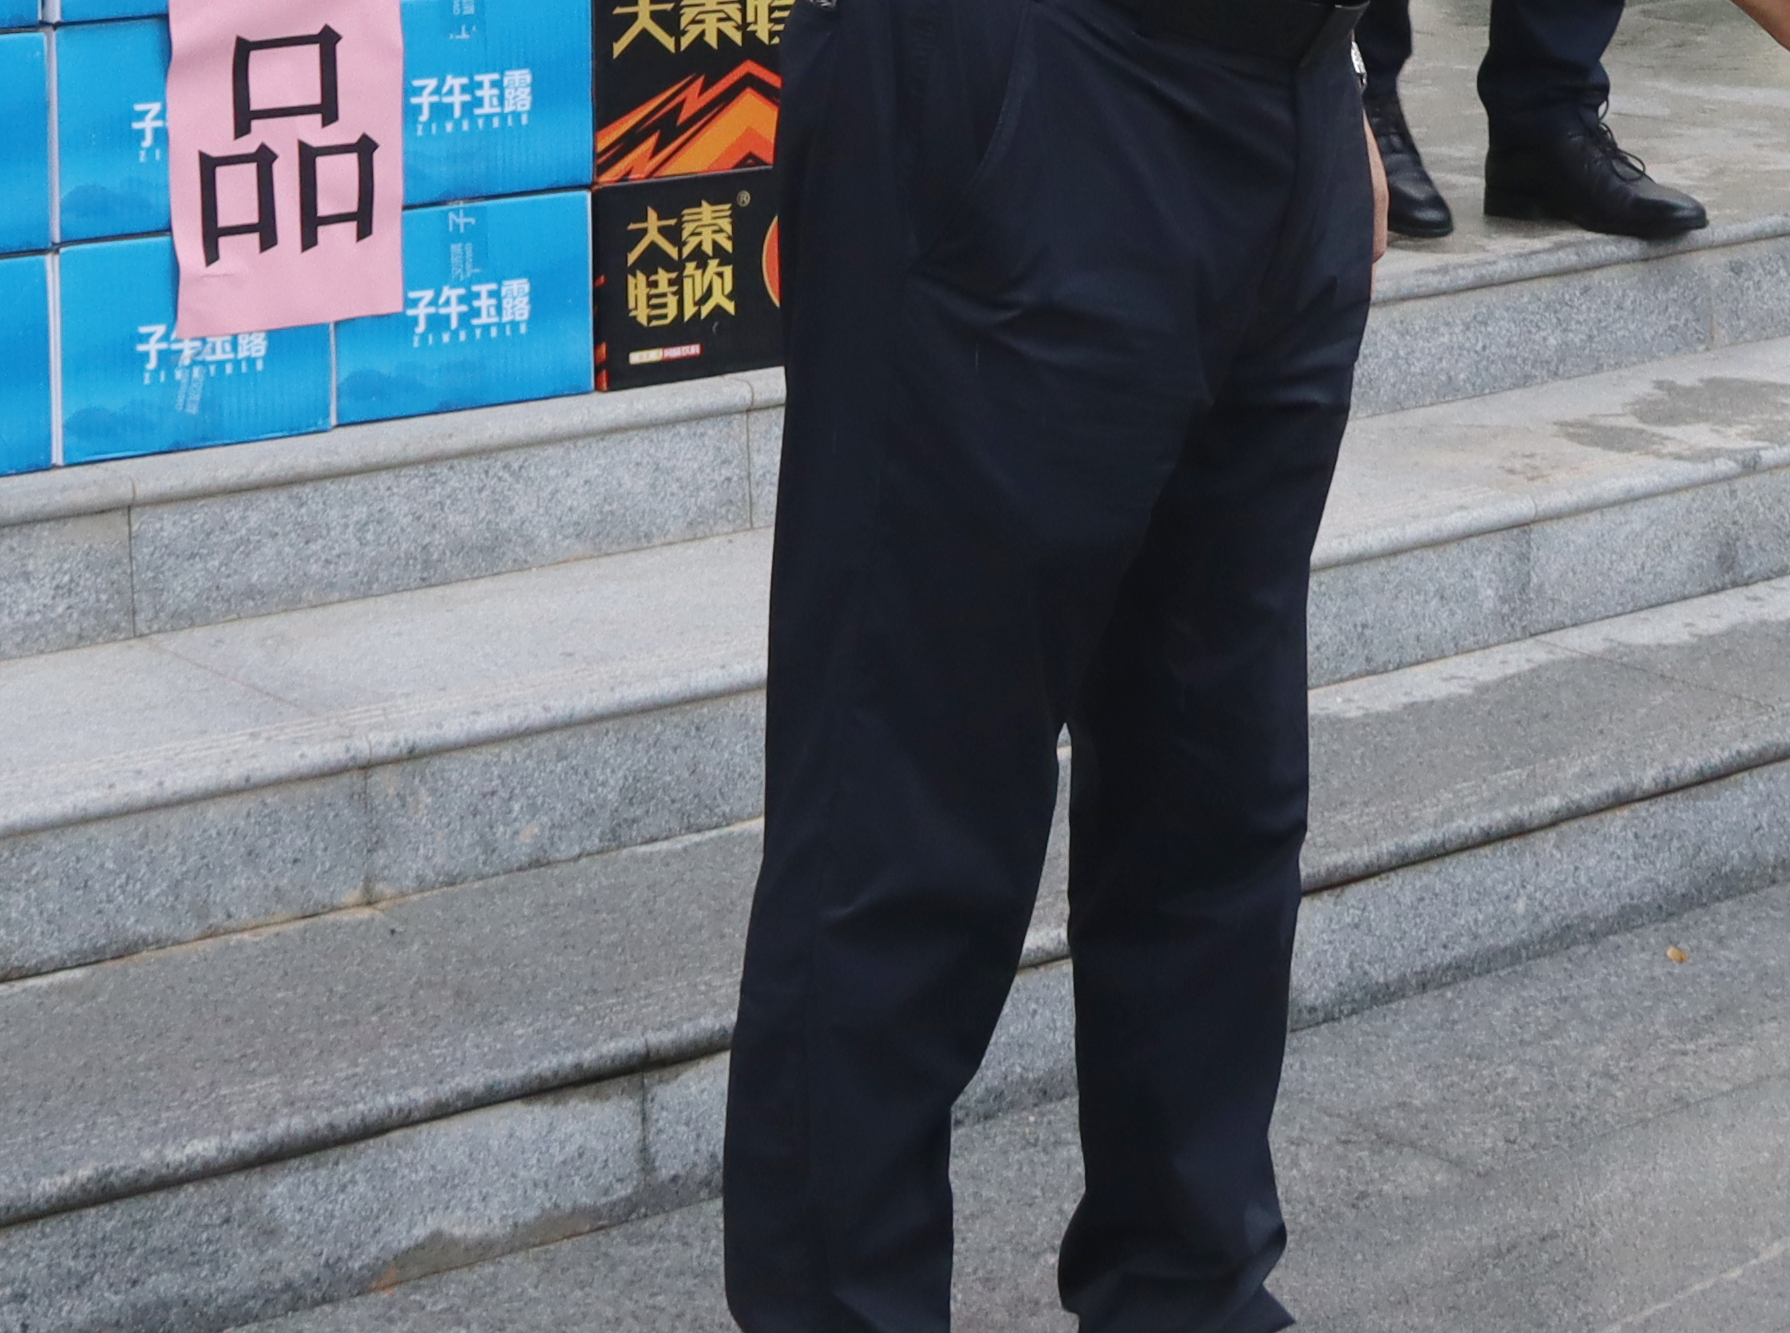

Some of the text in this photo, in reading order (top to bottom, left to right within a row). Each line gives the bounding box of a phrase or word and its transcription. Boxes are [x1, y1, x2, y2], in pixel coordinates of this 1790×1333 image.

[409, 68, 532, 122] 子午玉露
[405, 277, 531, 334] 子午玉露
